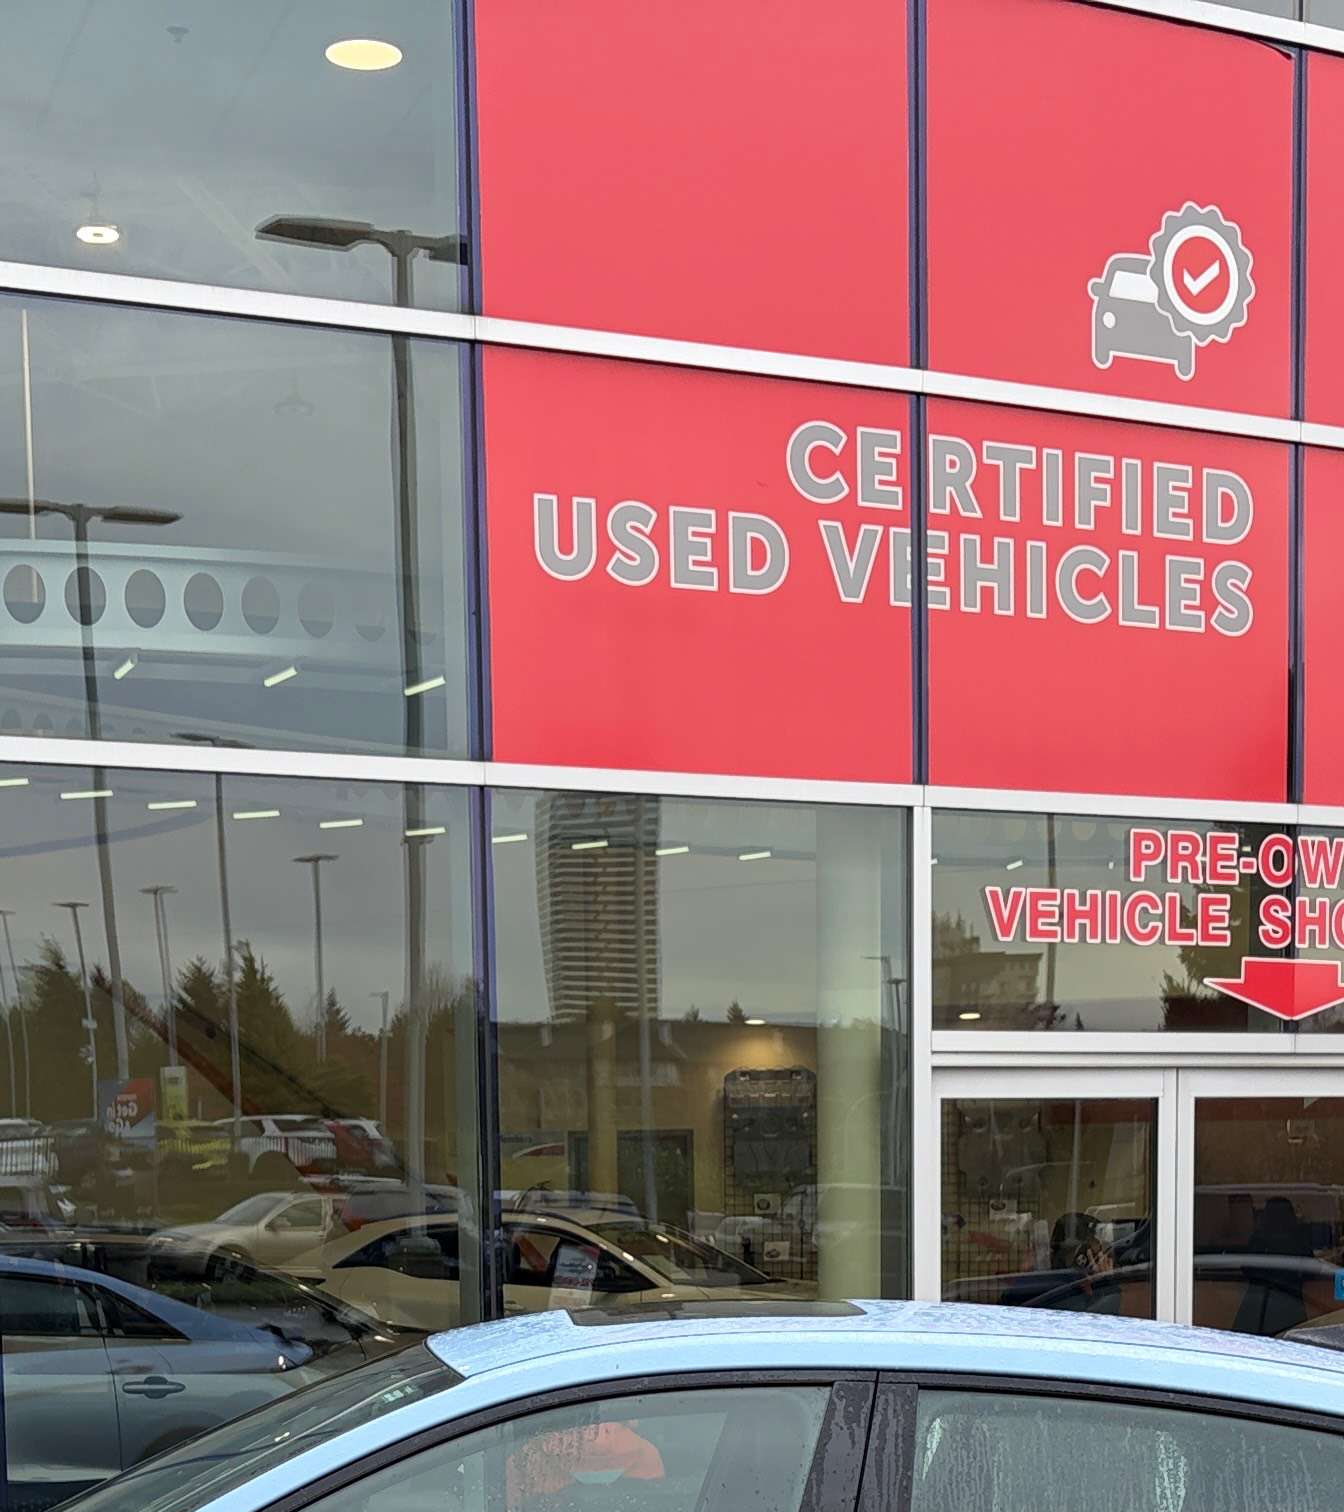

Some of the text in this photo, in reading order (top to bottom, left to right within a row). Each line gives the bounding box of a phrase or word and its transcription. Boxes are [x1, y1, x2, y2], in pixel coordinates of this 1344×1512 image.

[786, 421, 1254, 545] CERTIFIED
[533, 493, 1254, 636] USED VEHICLES
[985, 886, 1232, 946] VEHICLE
